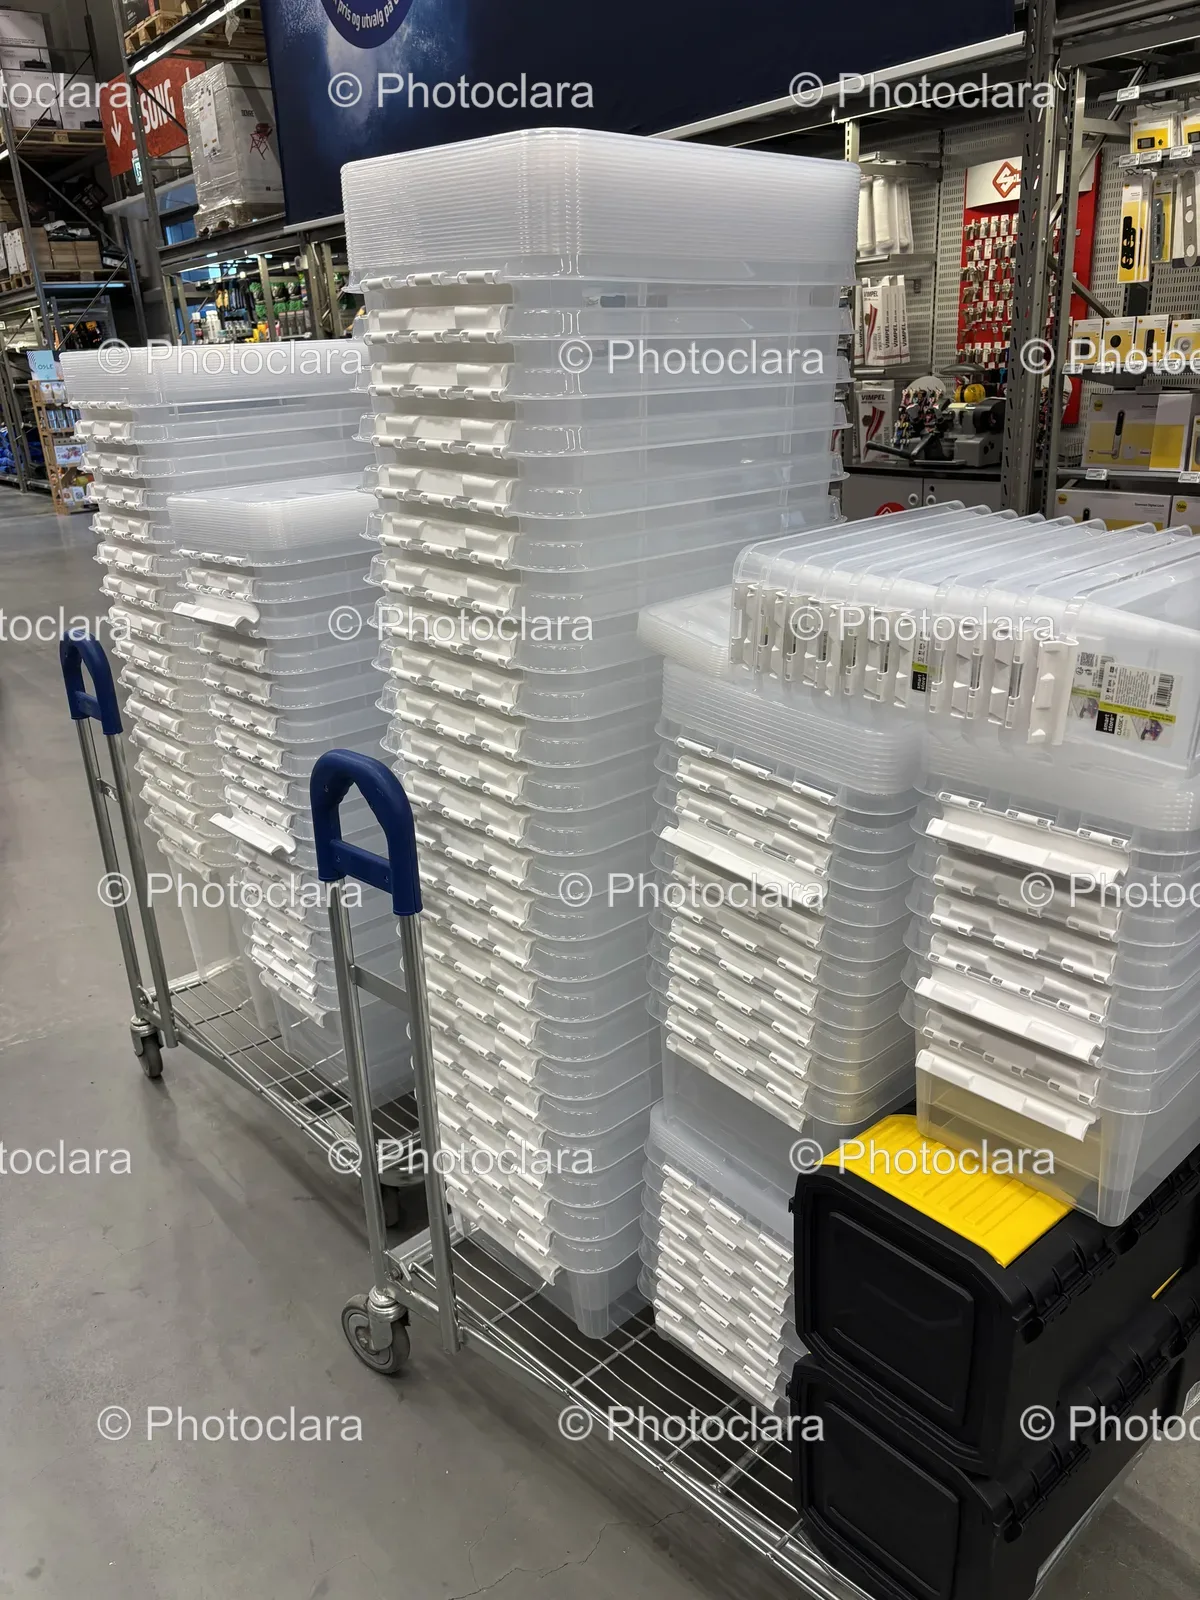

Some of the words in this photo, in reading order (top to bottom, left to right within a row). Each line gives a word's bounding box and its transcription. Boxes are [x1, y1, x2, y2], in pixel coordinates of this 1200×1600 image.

[337, 3, 351, 22] pris
[351, 12, 361, 31] og
[361, 8, 383, 29] utvalg
